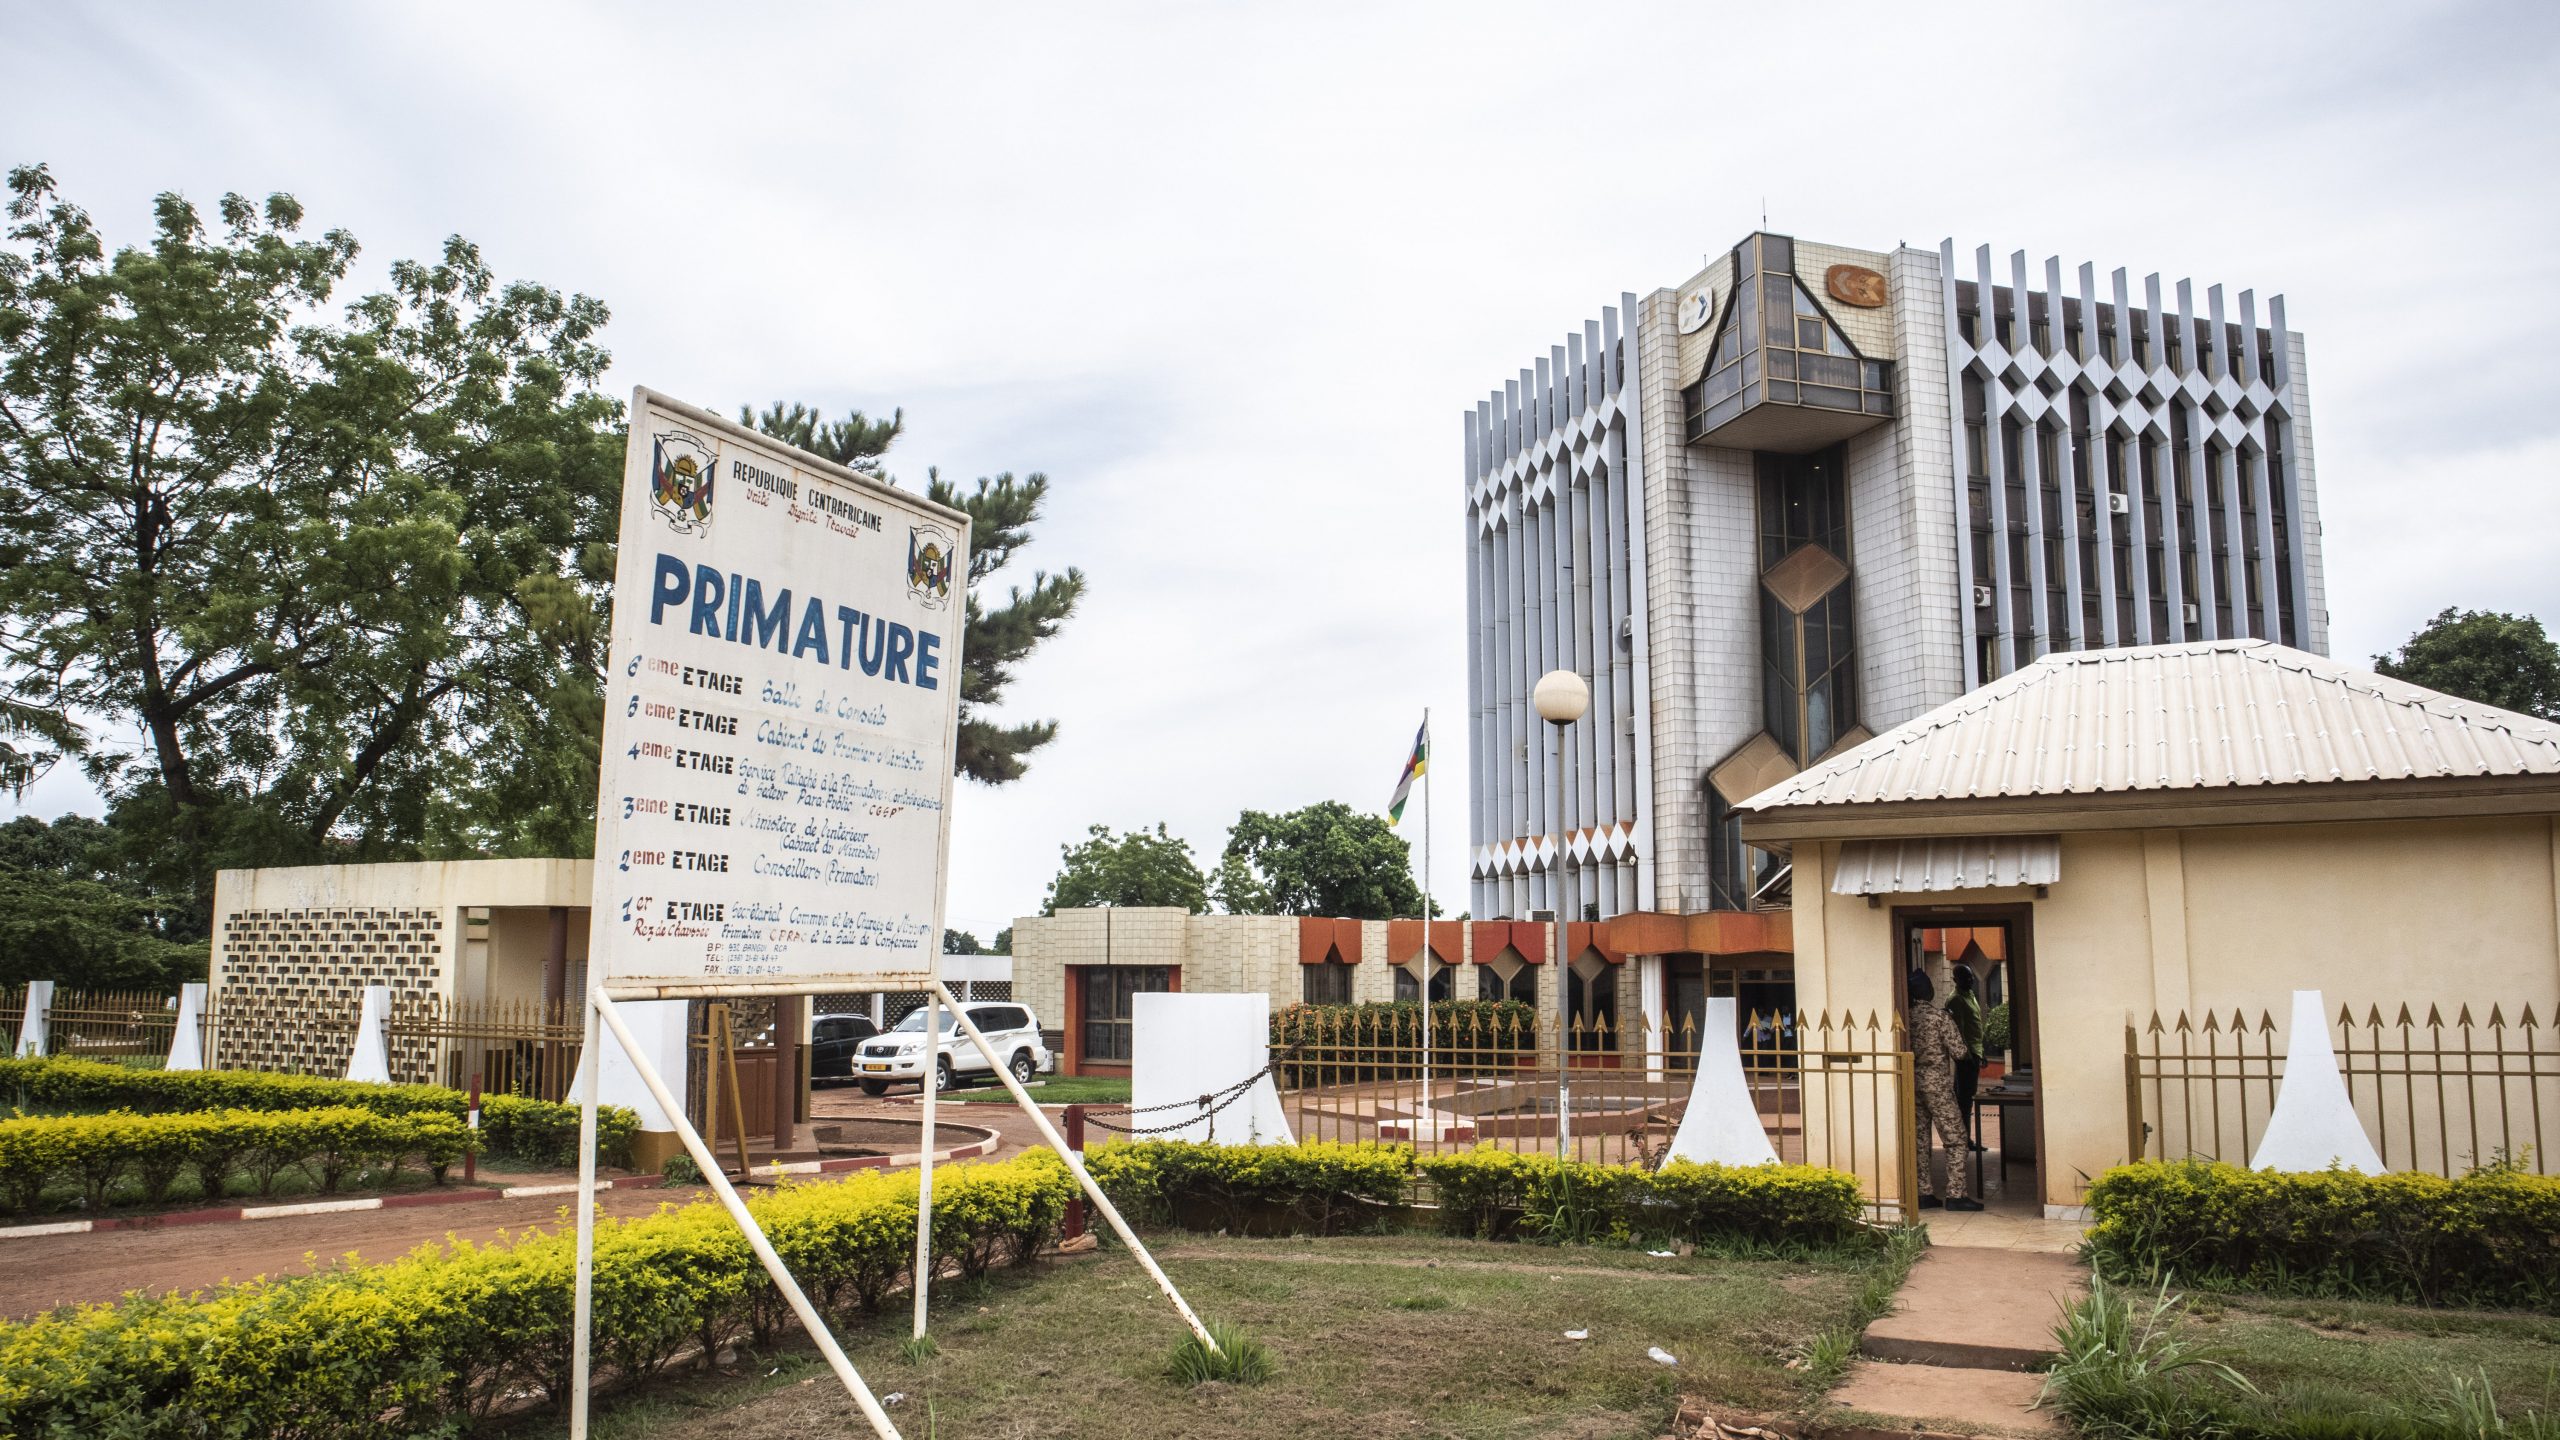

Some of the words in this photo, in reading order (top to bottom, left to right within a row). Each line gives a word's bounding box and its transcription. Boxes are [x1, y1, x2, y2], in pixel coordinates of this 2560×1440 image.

[733, 461, 798, 500] REPUBLIQUE
[808, 488, 882, 533] CENTRAFRICAINE
[826, 514, 860, 539] Travail
[650, 553, 941, 691] PRIMATURE
[682, 666, 743, 695] ETAGE
[762, 679, 802, 709] Salle
[815, 689, 830, 714] de
[837, 696, 887, 726] Conseils
[679, 708, 738, 736] ETAGE
[757, 719, 808, 750] Cabinet
[812, 730, 827, 755] du
[676, 749, 734, 775] ETAGE
[739, 758, 776, 781] Service
[757, 782, 788, 801] Secteur
[674, 802, 731, 826] ETAGE
[804, 817, 818, 836] de
[779, 834, 820, 853] (Cabinet
[822, 840, 834, 855] du
[672, 850, 729, 873] ETAGE
[753, 854, 821, 880] Conseillers
[824, 858, 880, 889] (Primature)
[667, 901, 724, 922] ETAGE
[721, 923, 762, 940] Primature
